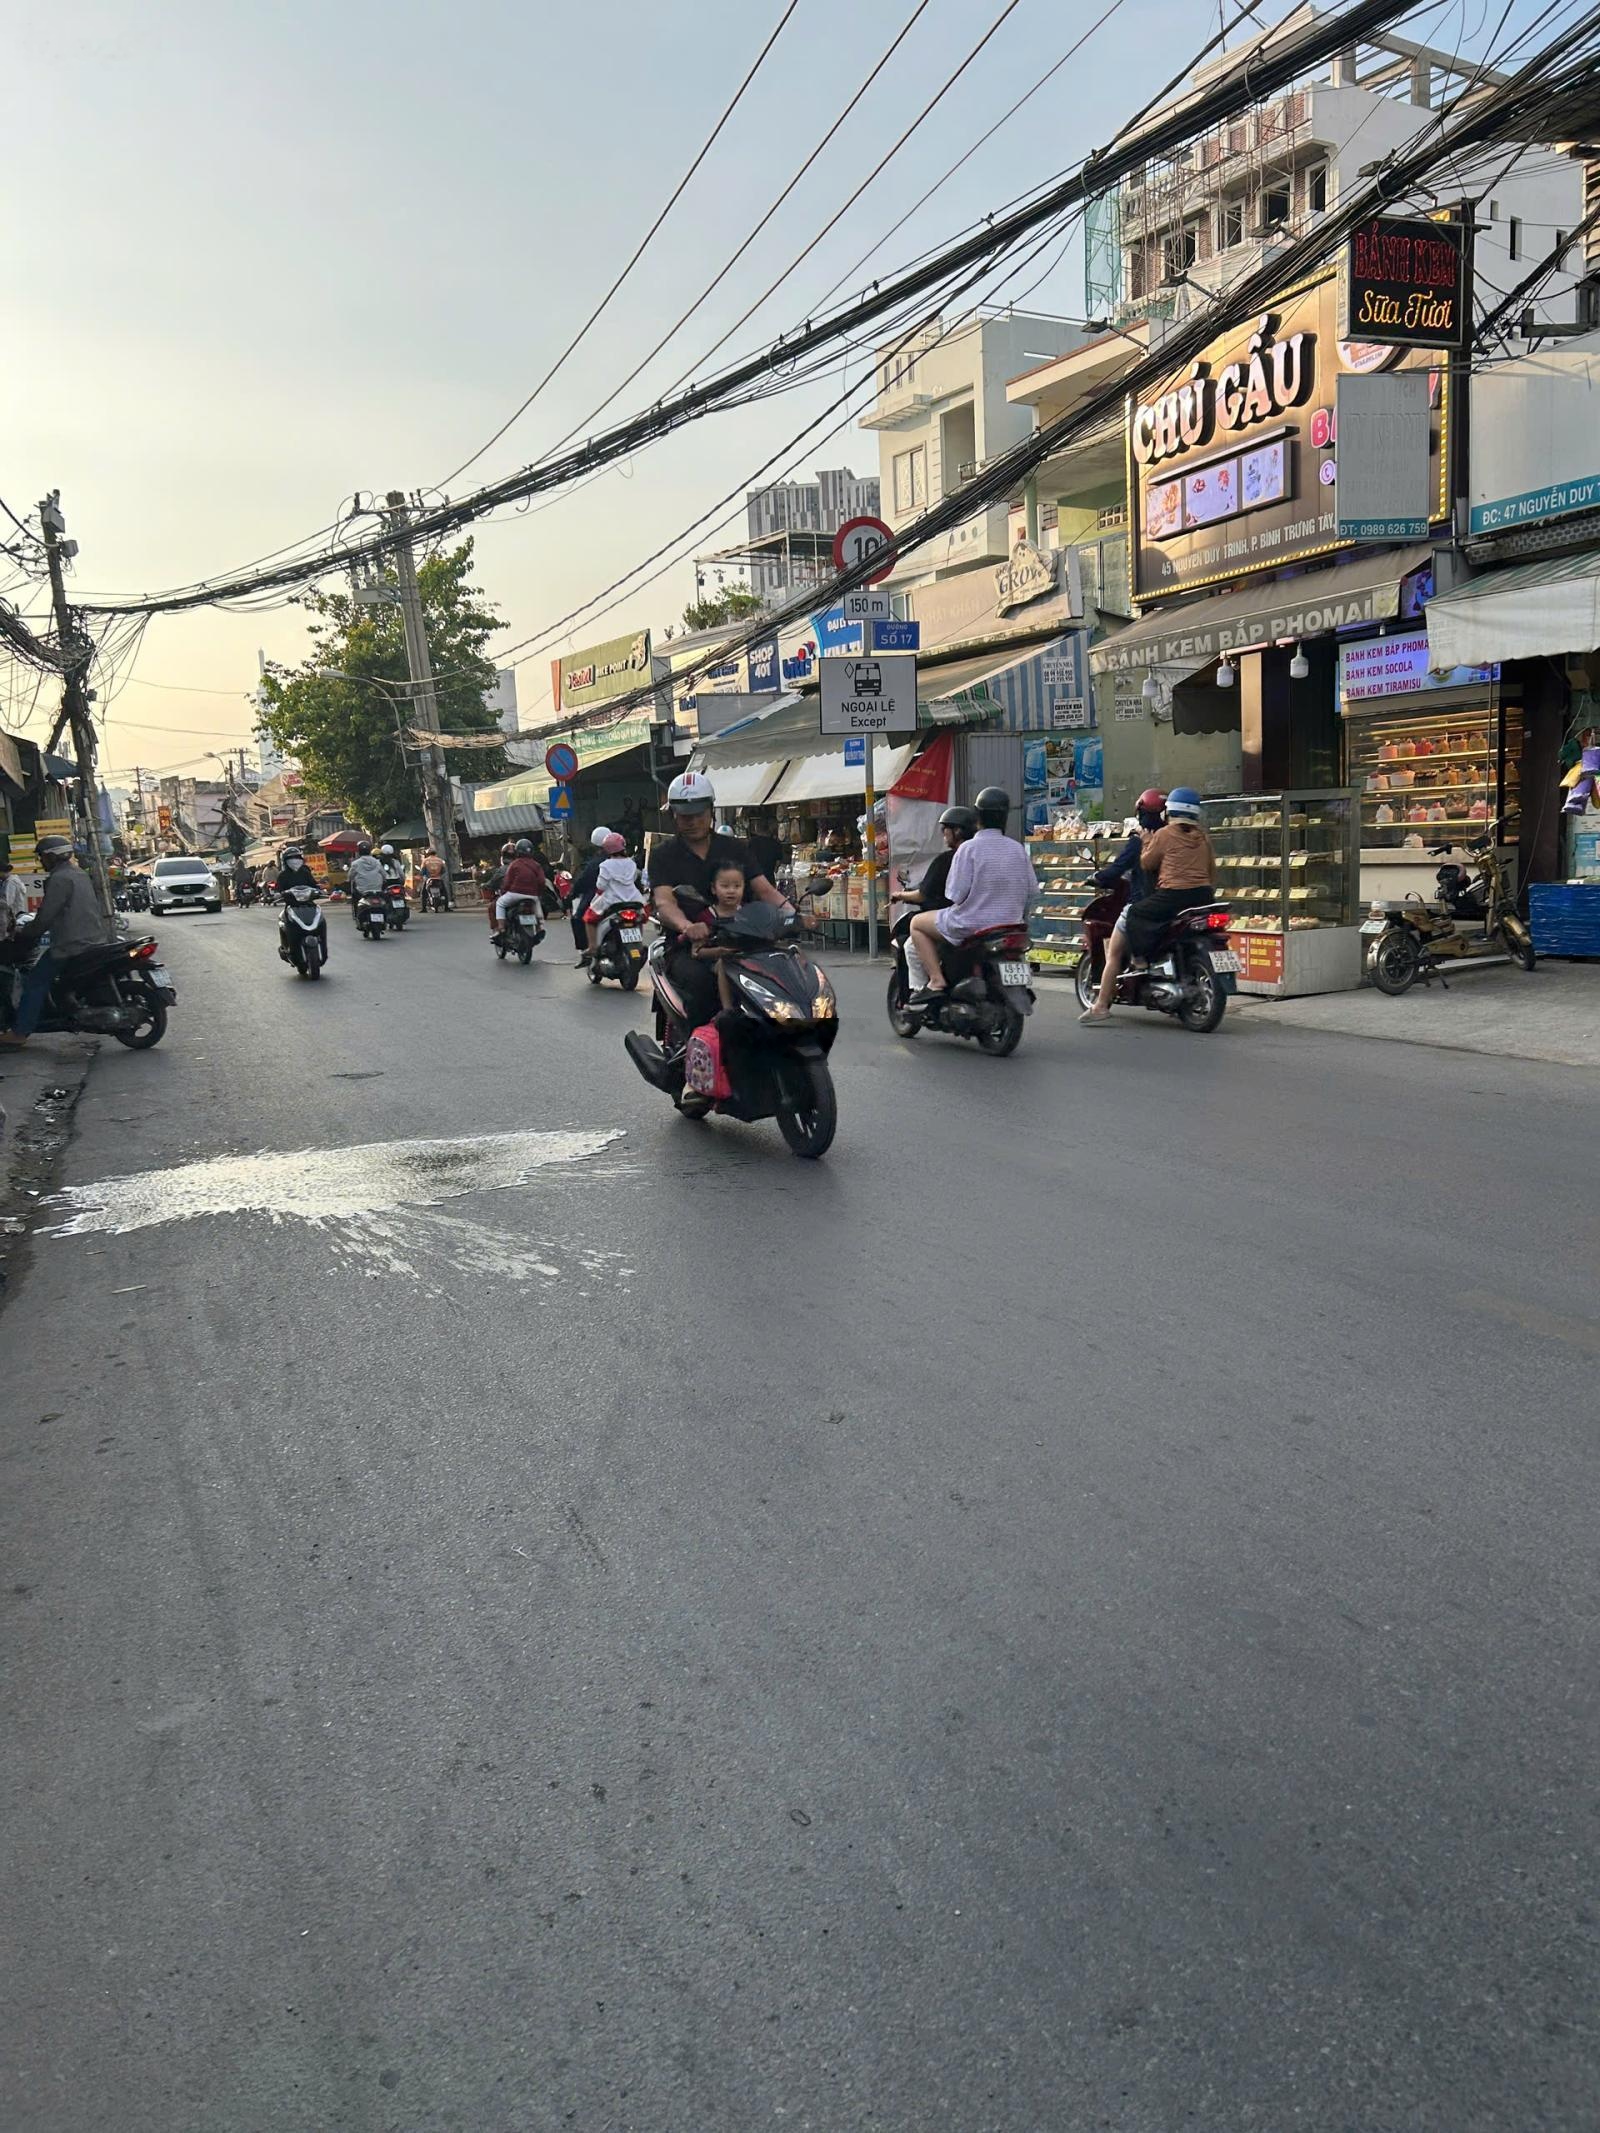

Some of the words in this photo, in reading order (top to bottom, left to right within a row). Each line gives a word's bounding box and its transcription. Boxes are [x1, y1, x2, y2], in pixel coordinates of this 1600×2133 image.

[1359, 289, 1402, 324] Sữa
[1405, 290, 1453, 328] Tươi
[1133, 361, 1207, 464] CHÚ
[1215, 313, 1306, 431] GẤU
[1482, 510, 1501, 526] ĐC:
[1503, 504, 1517, 520] 47
[1518, 486, 1566, 517] NGUYỄN
[1569, 481, 1594, 505] DUY
[1340, 523, 1358, 537] ĐT:
[1360, 523, 1385, 536] 0989
[1387, 523, 1406, 535] 626
[1408, 522, 1427, 535] 759
[1161, 561, 1172, 577] 45
[1204, 550, 1221, 565] DUY
[1251, 538, 1259, 551] P.
[1284, 518, 1316, 542] TRƯNG
[850, 598, 868, 613] 150
[871, 600, 884, 612] m
[880, 631, 898, 645] SỐ
[901, 634, 913, 645] 17
[1107, 644, 1159, 671] BÁNH
[1165, 633, 1213, 660] KEM
[1218, 619, 1265, 650] BẮP
[1270, 599, 1373, 637] PHOMAI
[750, 645, 774, 665] SHOP
[1367, 647, 1383, 660] KEM
[1402, 638, 1429, 654] PHOMA
[755, 661, 771, 679] 401
[1367, 665, 1384, 677] KEM
[1384, 660, 1413, 675] SOCOLA
[1367, 683, 1384, 695] KEM
[1386, 678, 1421, 693] TIRAMISU
[841, 701, 877, 716] NGOẠI
[881, 698, 896, 714] LỆ
[850, 716, 887, 729] Except
